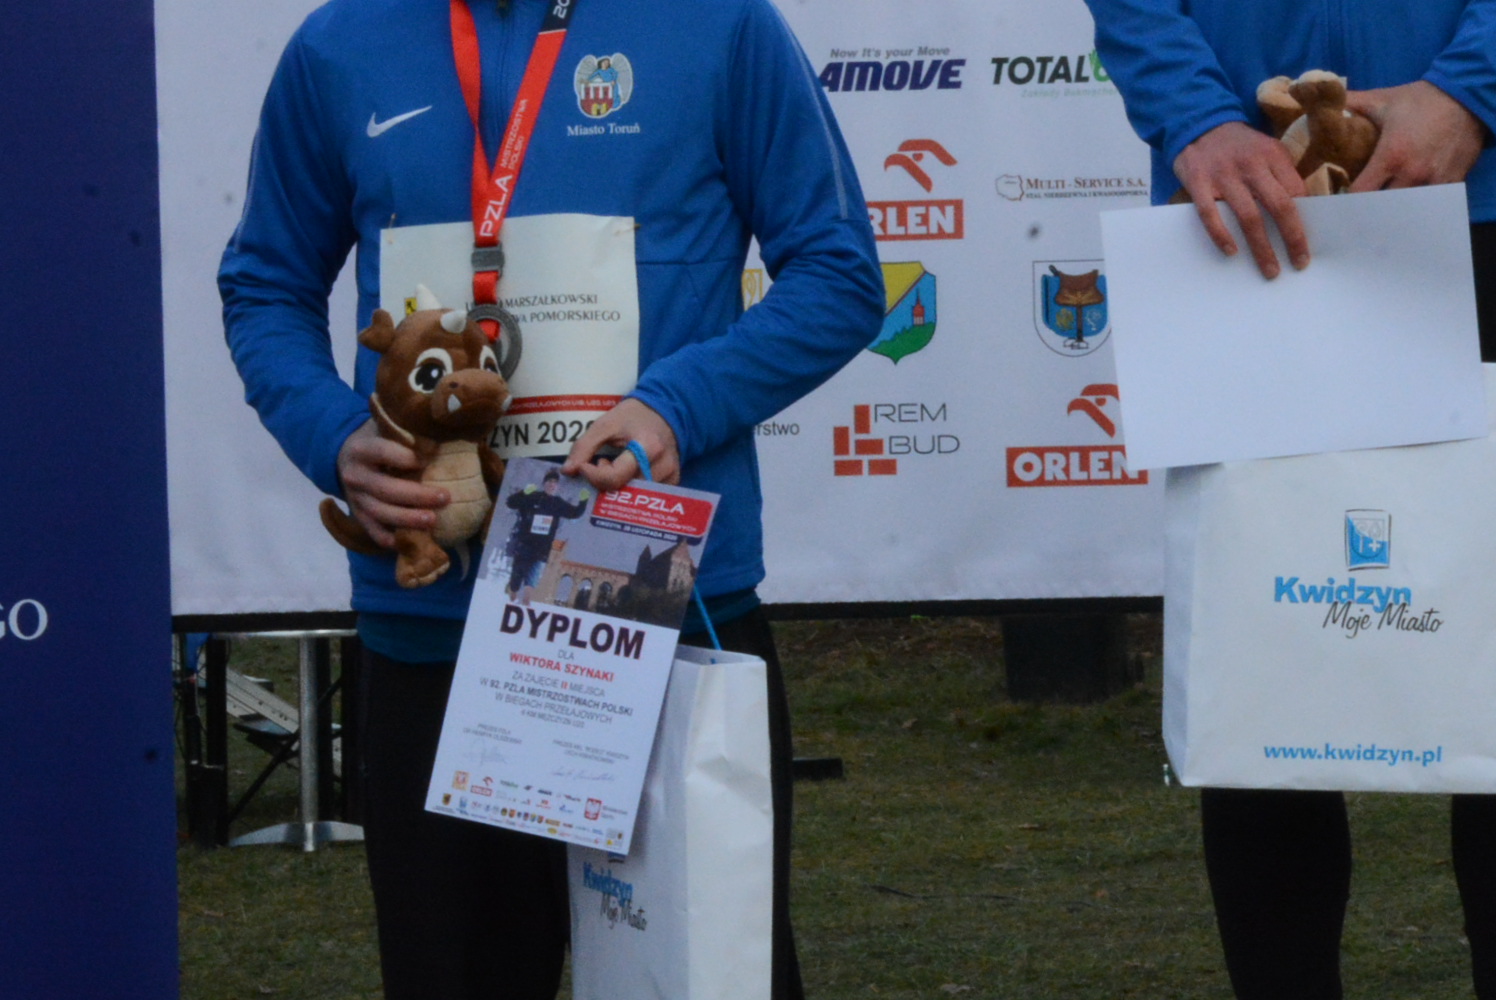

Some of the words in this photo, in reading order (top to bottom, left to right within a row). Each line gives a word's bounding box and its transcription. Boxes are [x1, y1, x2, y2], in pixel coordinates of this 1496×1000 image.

[830, 48, 858, 59] Now
[918, 46, 951, 56] Move
[567, 124, 605, 137] Miasto
[607, 122, 641, 136] Toruń
[479, 174, 513, 238] PZLA
[873, 205, 955, 236] RLEN
[505, 294, 598, 308] MARSZAŁKOWSKI
[530, 310, 621, 323] POMORSKIEGO
[874, 403, 947, 423] REM
[888, 435, 960, 454] BUD
[1275, 576, 1412, 613] Kwidzyn
[1322, 601, 1372, 639] Moje
[1377, 602, 1444, 633] Miasto
[499, 603, 646, 660] DYPLOM
[557, 649, 574, 660] DLA
[510, 652, 561, 672] WIKTORA
[564, 663, 614, 682] SZYNAKI
[601, 702, 633, 716] POLSKI
[1263, 742, 1442, 767] www.kwidzyn.pl
